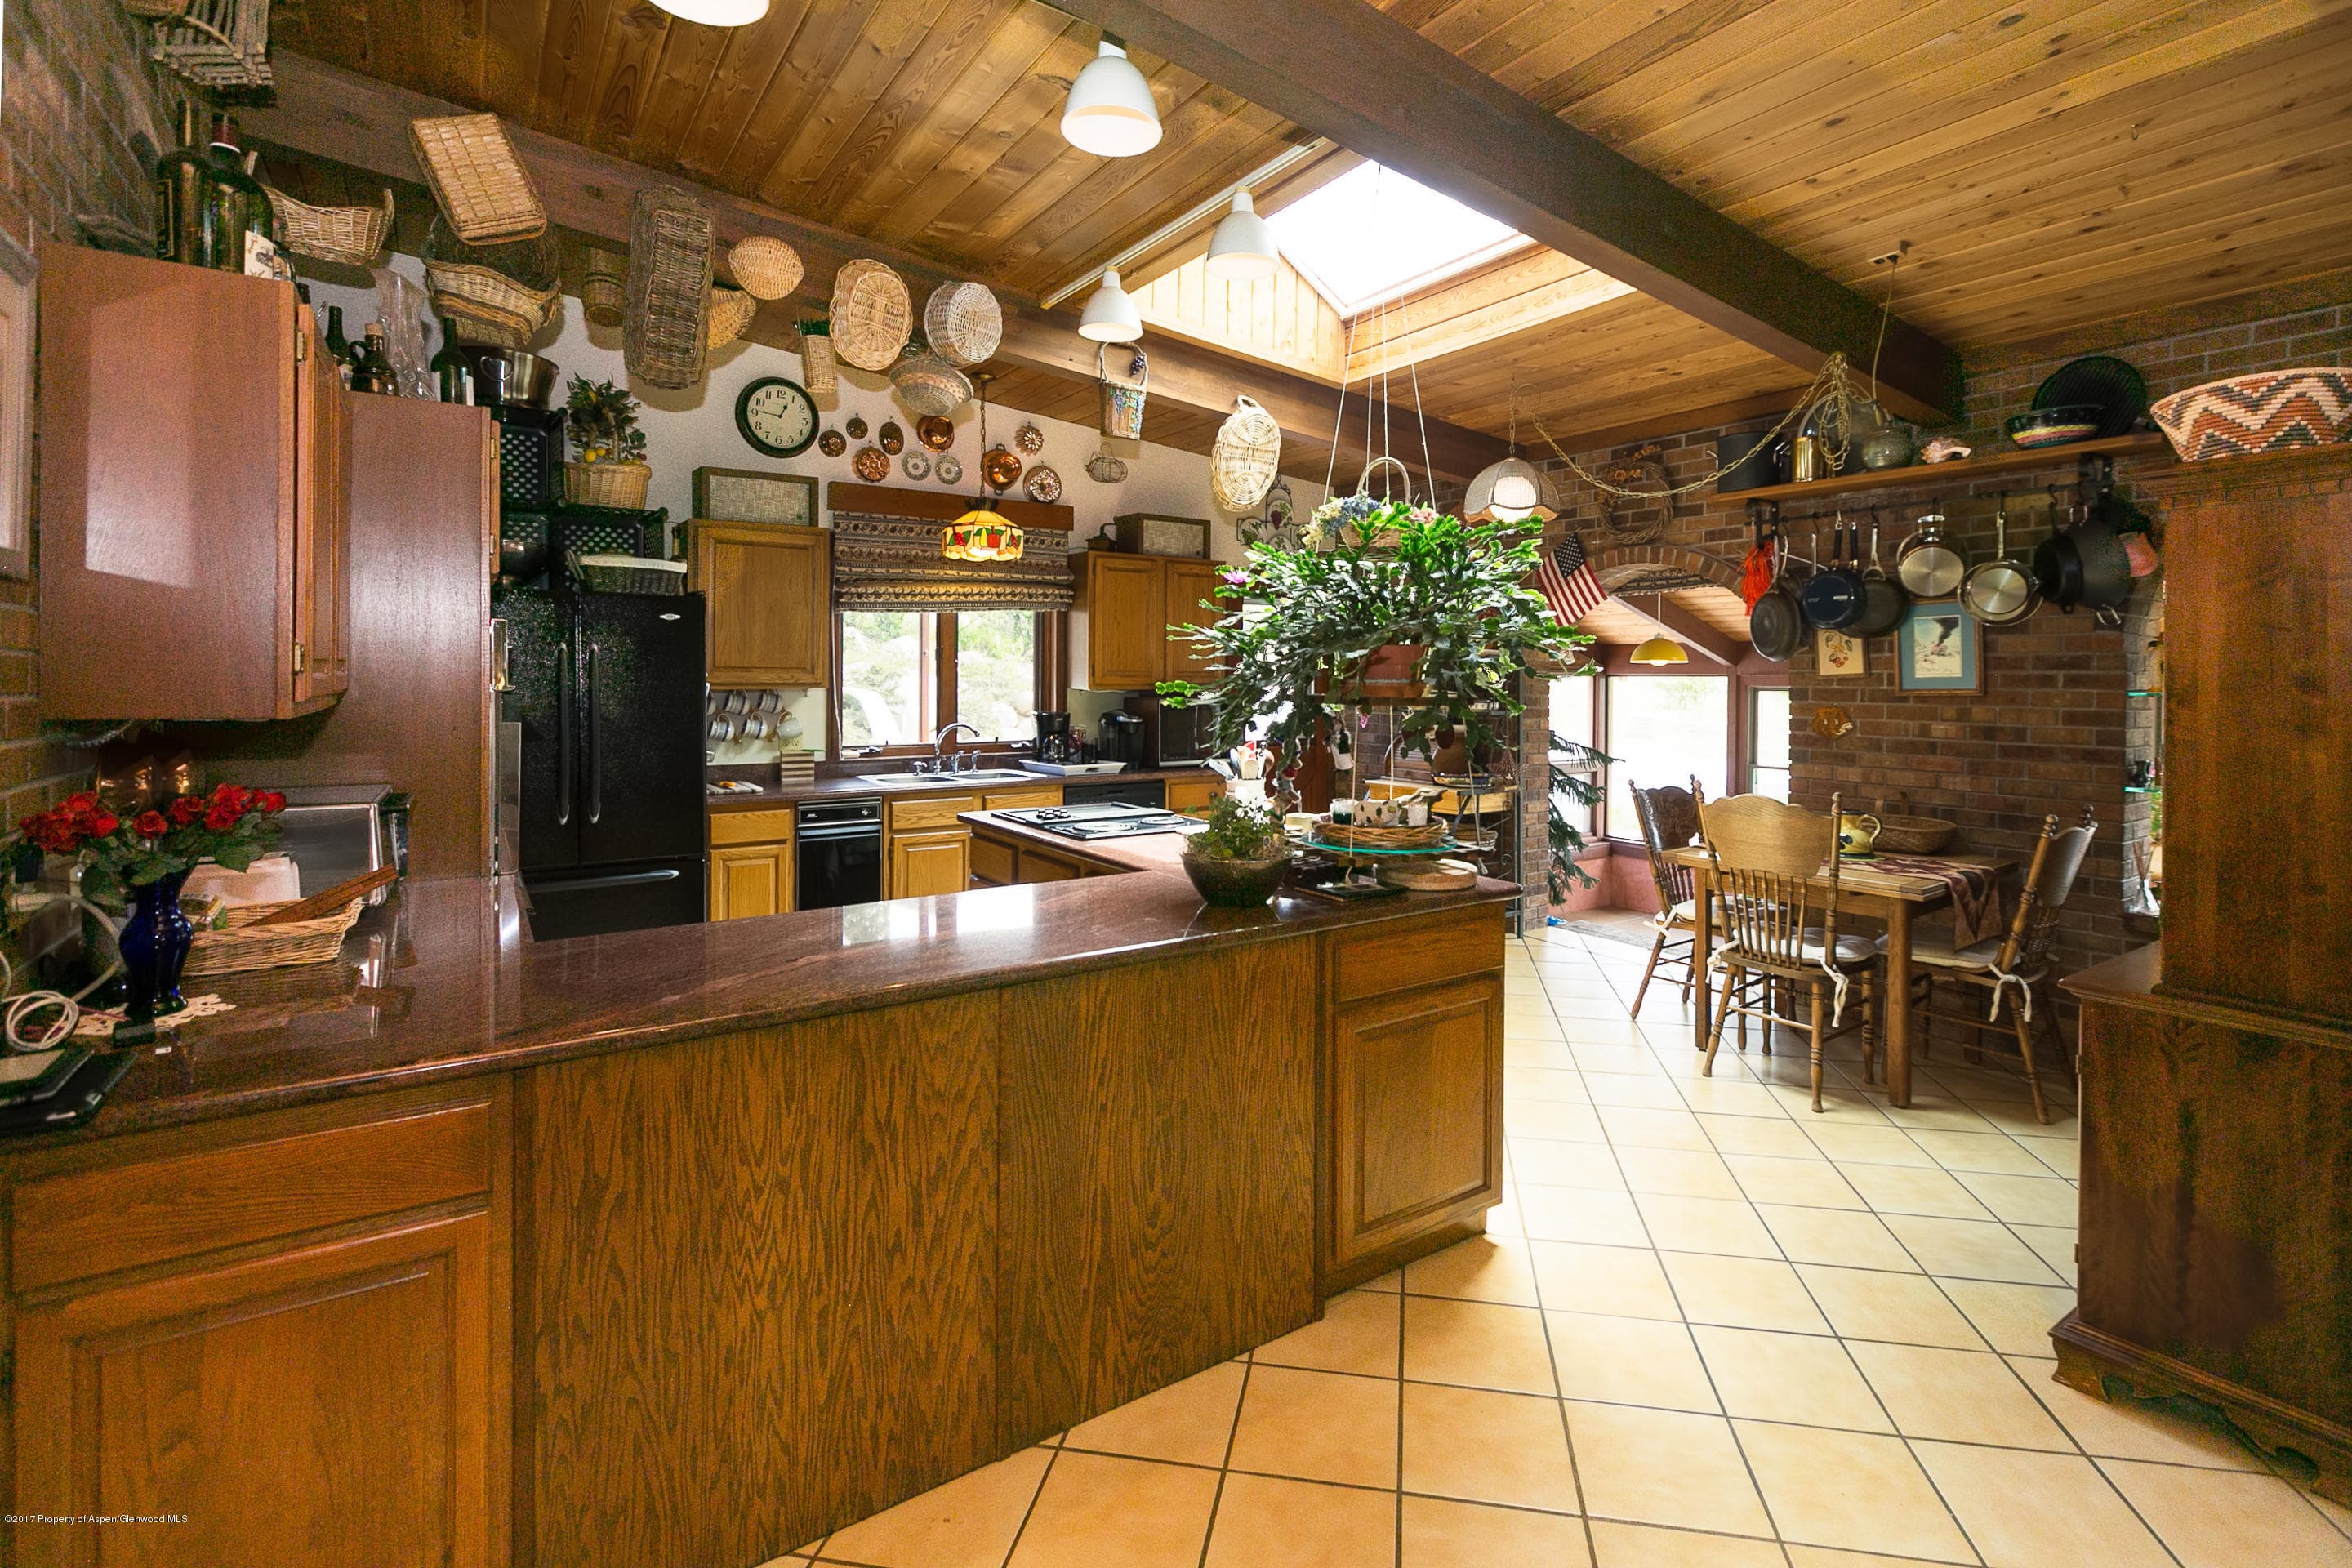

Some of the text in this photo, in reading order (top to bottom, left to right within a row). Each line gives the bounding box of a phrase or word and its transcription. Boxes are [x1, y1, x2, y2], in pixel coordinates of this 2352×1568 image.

[765, 390, 772, 399] 11
[777, 390, 786, 399] 12
[755, 397, 765, 407] 10
[751, 408, 759, 417] 9
[799, 404, 805, 413] 2
[755, 421, 762, 430] 8
[764, 431, 771, 439] 7
[775, 435, 782, 445] 6
